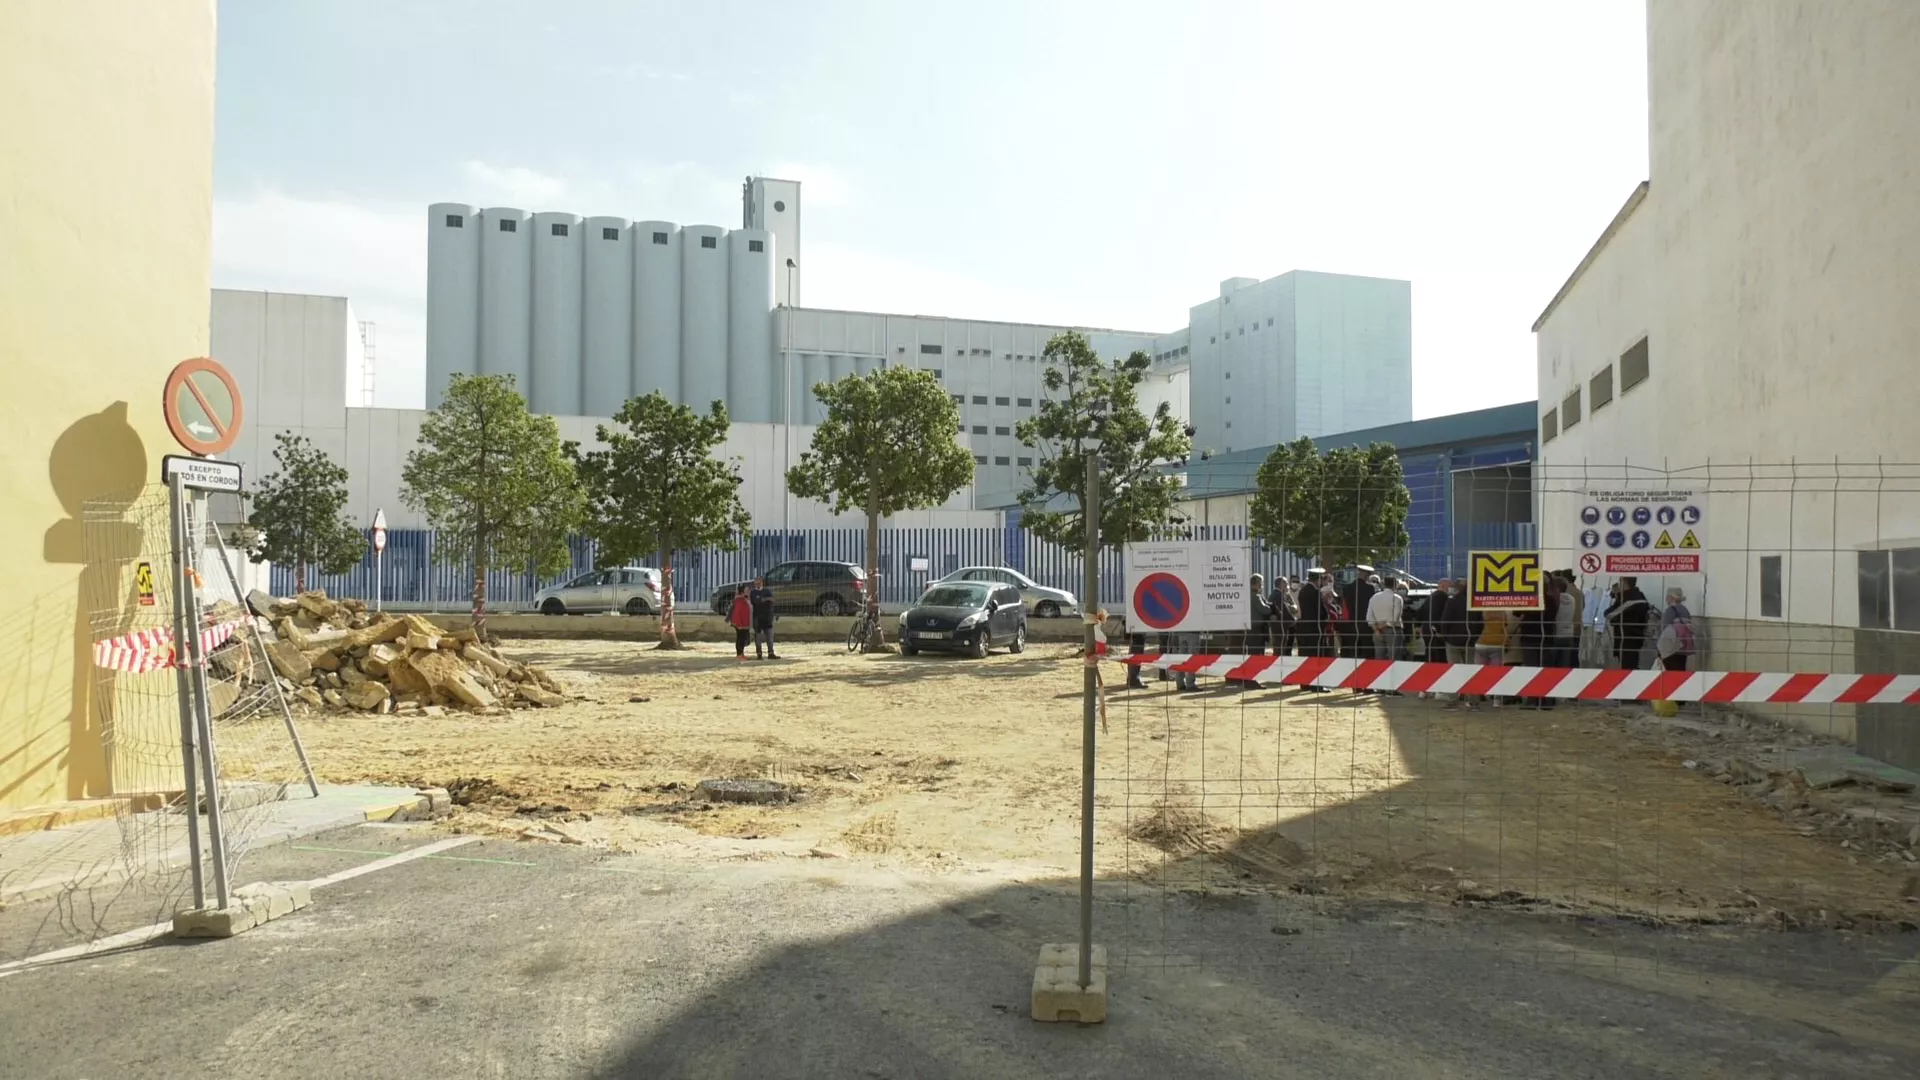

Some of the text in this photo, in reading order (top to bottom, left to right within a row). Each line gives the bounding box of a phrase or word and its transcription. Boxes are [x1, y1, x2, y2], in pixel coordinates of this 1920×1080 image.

[189, 465, 221, 474] EXCEPTO
[209, 476, 238, 486] CORDON
[1212, 555, 1231, 563] DIAS
[1475, 557, 1535, 592] MC
[1207, 592, 1240, 600] MOTIVO
